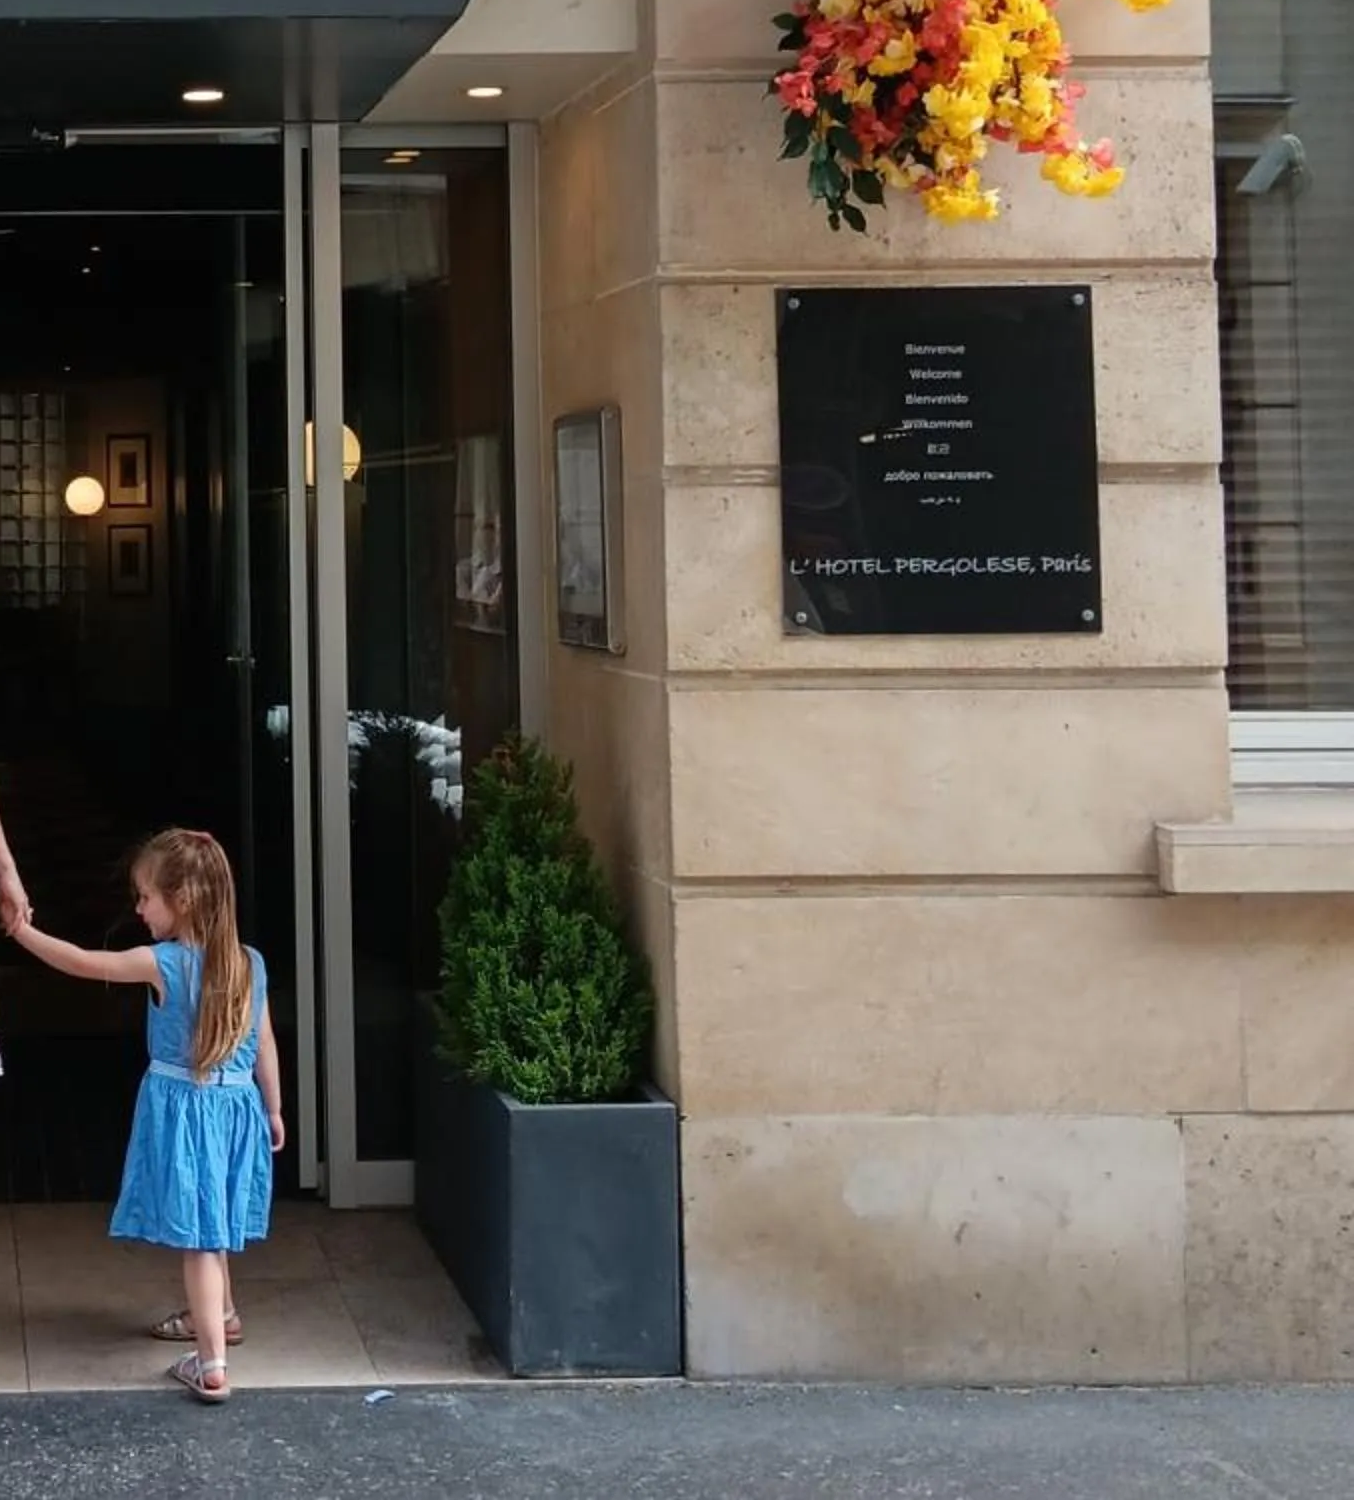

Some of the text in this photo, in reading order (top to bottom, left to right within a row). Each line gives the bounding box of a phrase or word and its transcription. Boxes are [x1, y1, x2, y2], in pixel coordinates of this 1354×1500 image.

[904, 342, 966, 356] Bienvenue
[909, 367, 963, 381] Welcome
[904, 392, 969, 405] Bienvenido
[814, 558, 891, 577] HOTEL
[894, 556, 1037, 578] PERGOLESE,
